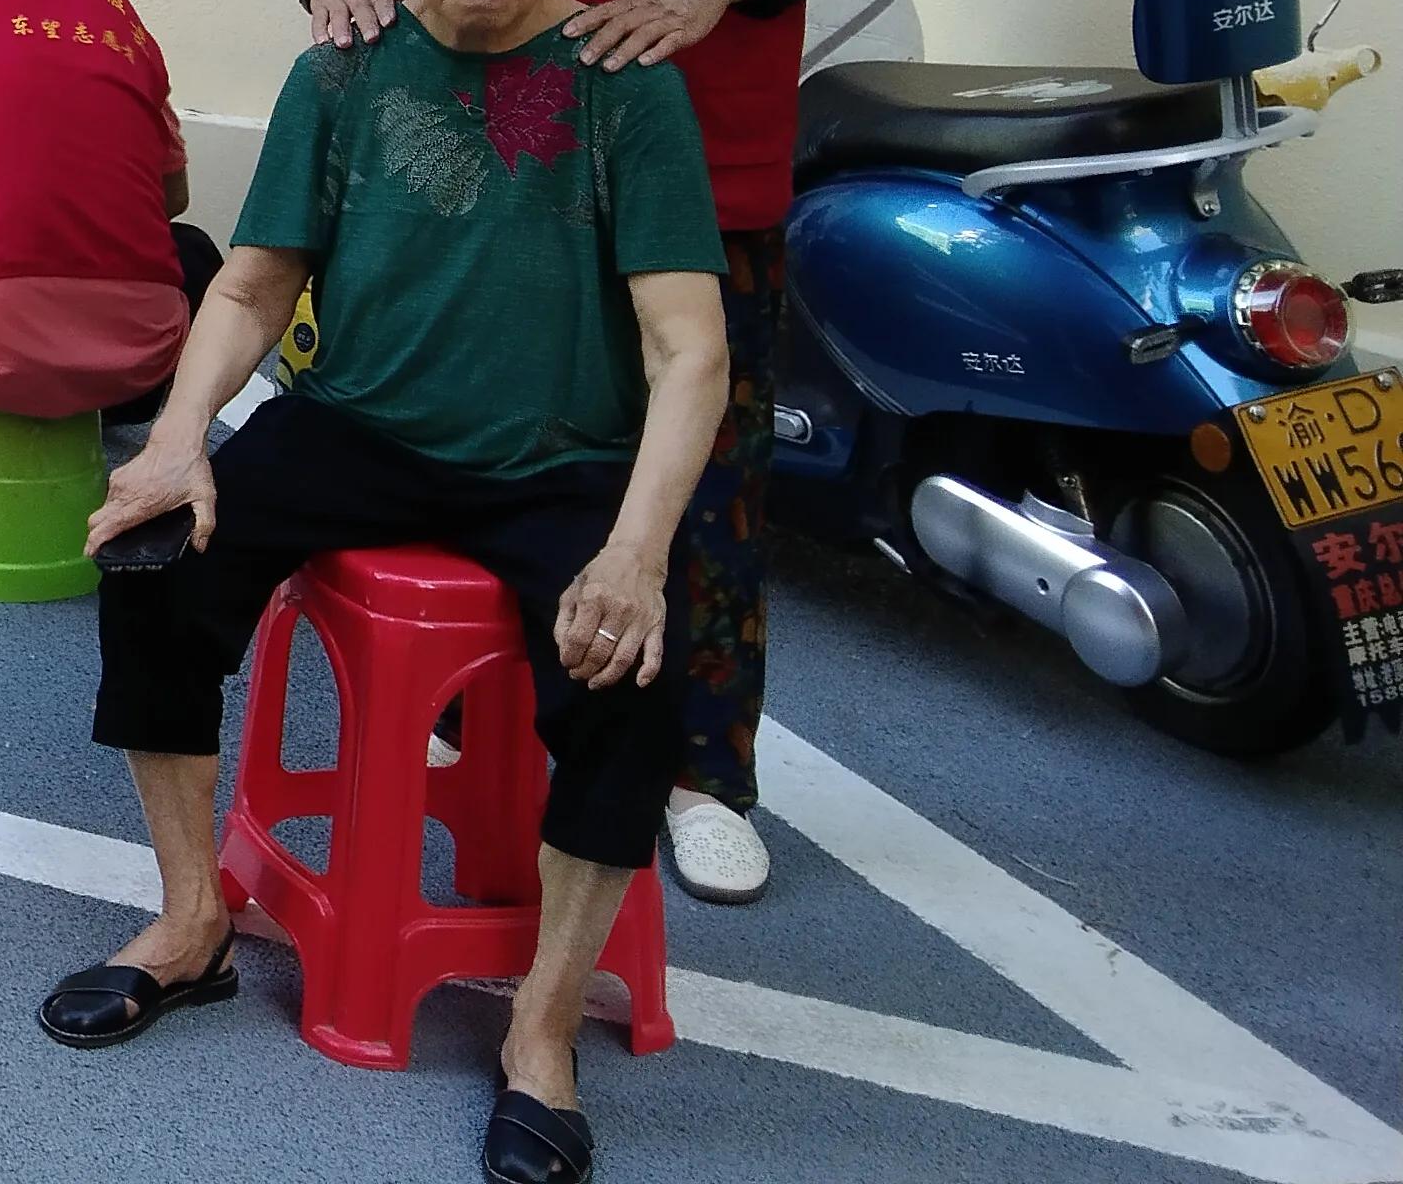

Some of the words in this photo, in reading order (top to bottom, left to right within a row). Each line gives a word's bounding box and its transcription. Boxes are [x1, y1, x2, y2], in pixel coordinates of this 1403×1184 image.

[1212, 0, 1276, 32] 安尔达
[961, 352, 1025, 374] 安尔达
[1273, 430, 1403, 518] WW56
[1332, 569, 1403, 619] 重庆总
